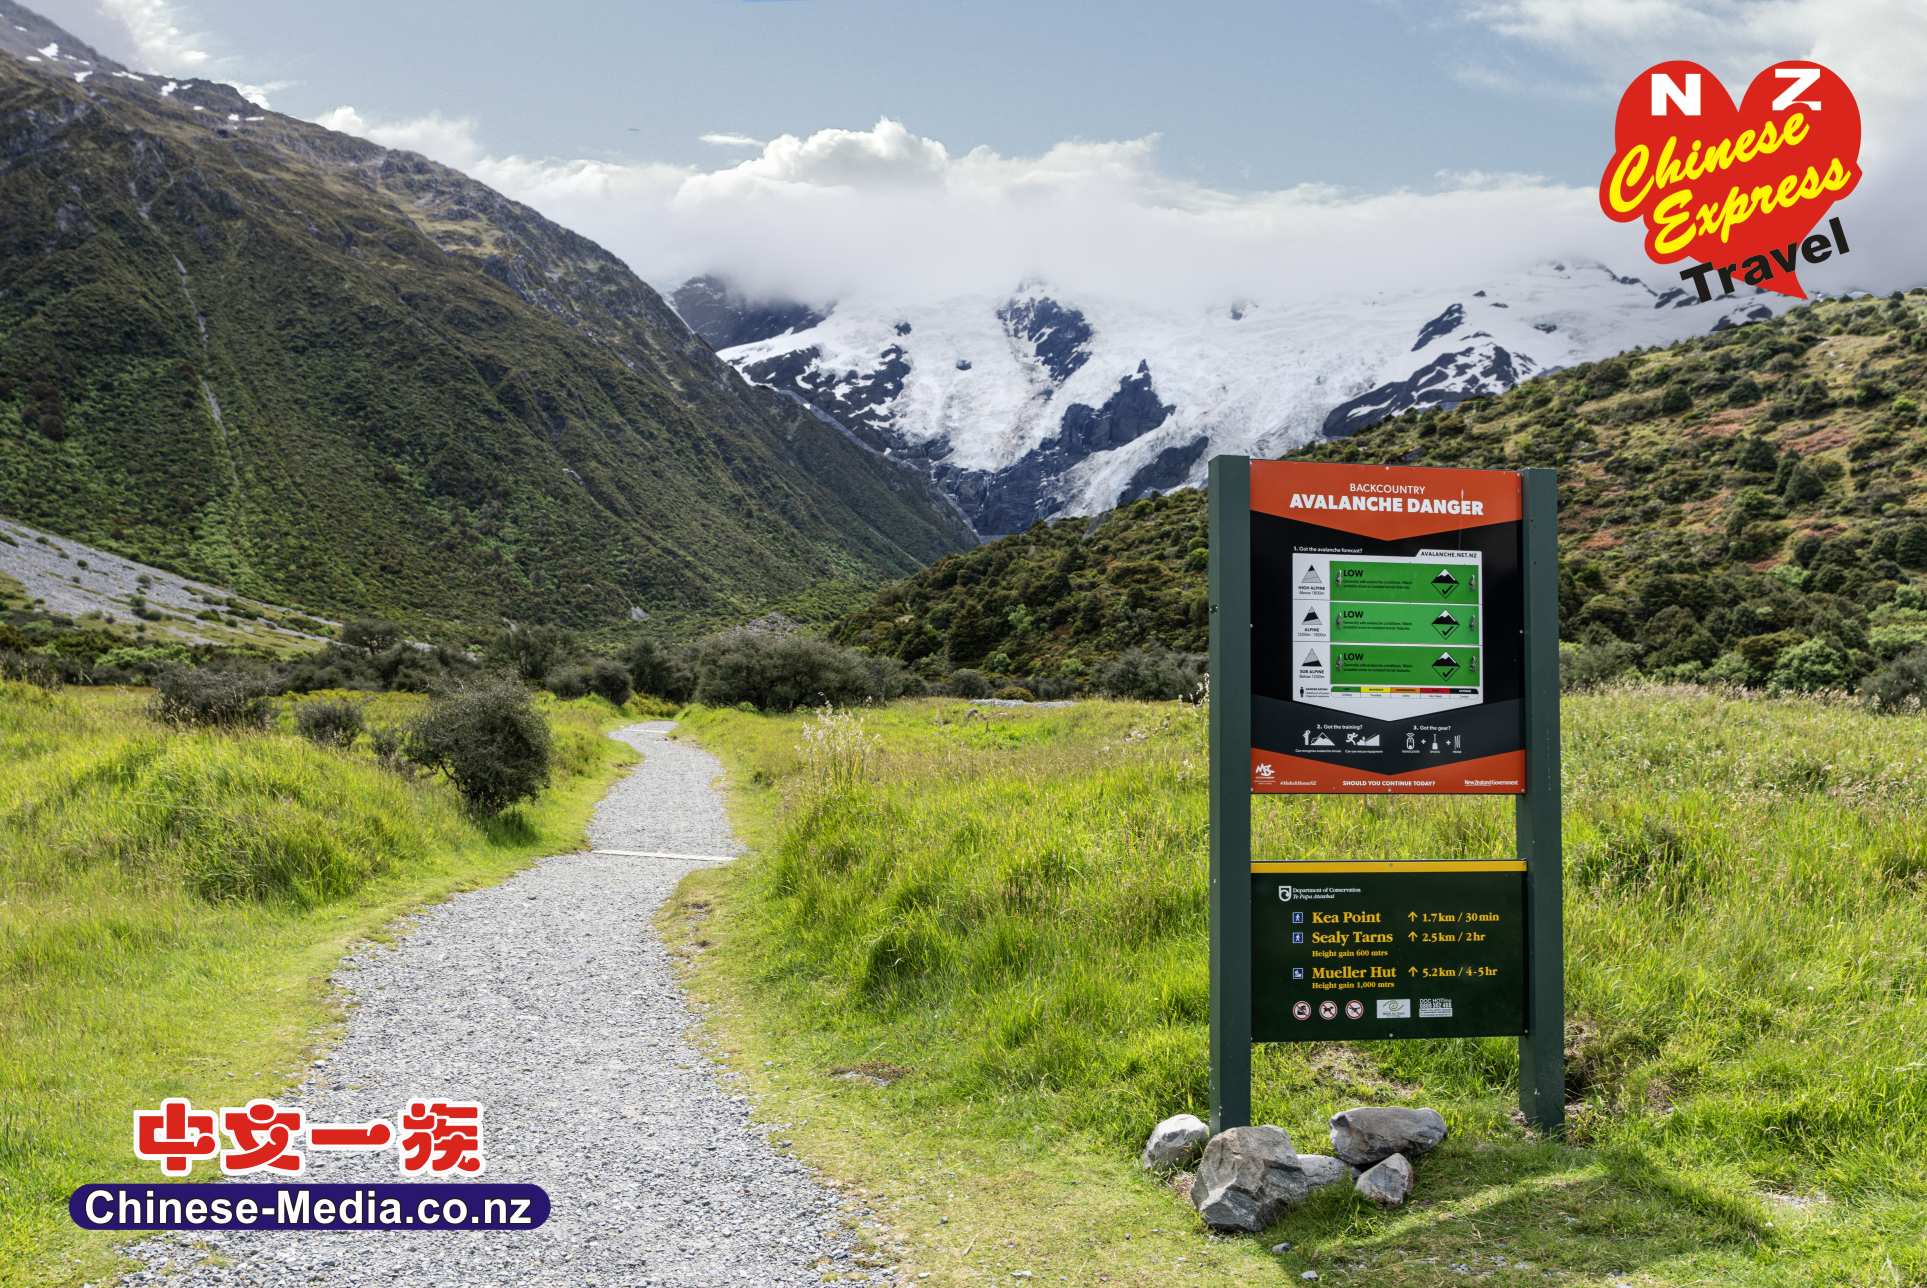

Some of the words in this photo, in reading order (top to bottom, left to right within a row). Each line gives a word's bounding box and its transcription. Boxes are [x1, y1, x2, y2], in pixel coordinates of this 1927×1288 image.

[1349, 483, 1426, 495] BACKCOUNTRY
[1289, 494, 1403, 513] AVALANCHE
[1407, 498, 1485, 516] DANGER
[1420, 551, 1477, 559] AVALANCHE.NET.NZ
[1343, 569, 1364, 577] LOW
[1343, 653, 1364, 661] LOW
[1312, 911, 1339, 924] Kea
[1343, 910, 1382, 924] Point
[1312, 930, 1350, 946] Sealy
[1353, 931, 1394, 943] Tarns
[1311, 950, 1336, 958] Height
[1338, 950, 1354, 958] gain
[1311, 966, 1367, 979] Mueller
[1370, 966, 1397, 979] Hut
[1311, 982, 1336, 990] Height
[1338, 982, 1354, 990] gain
